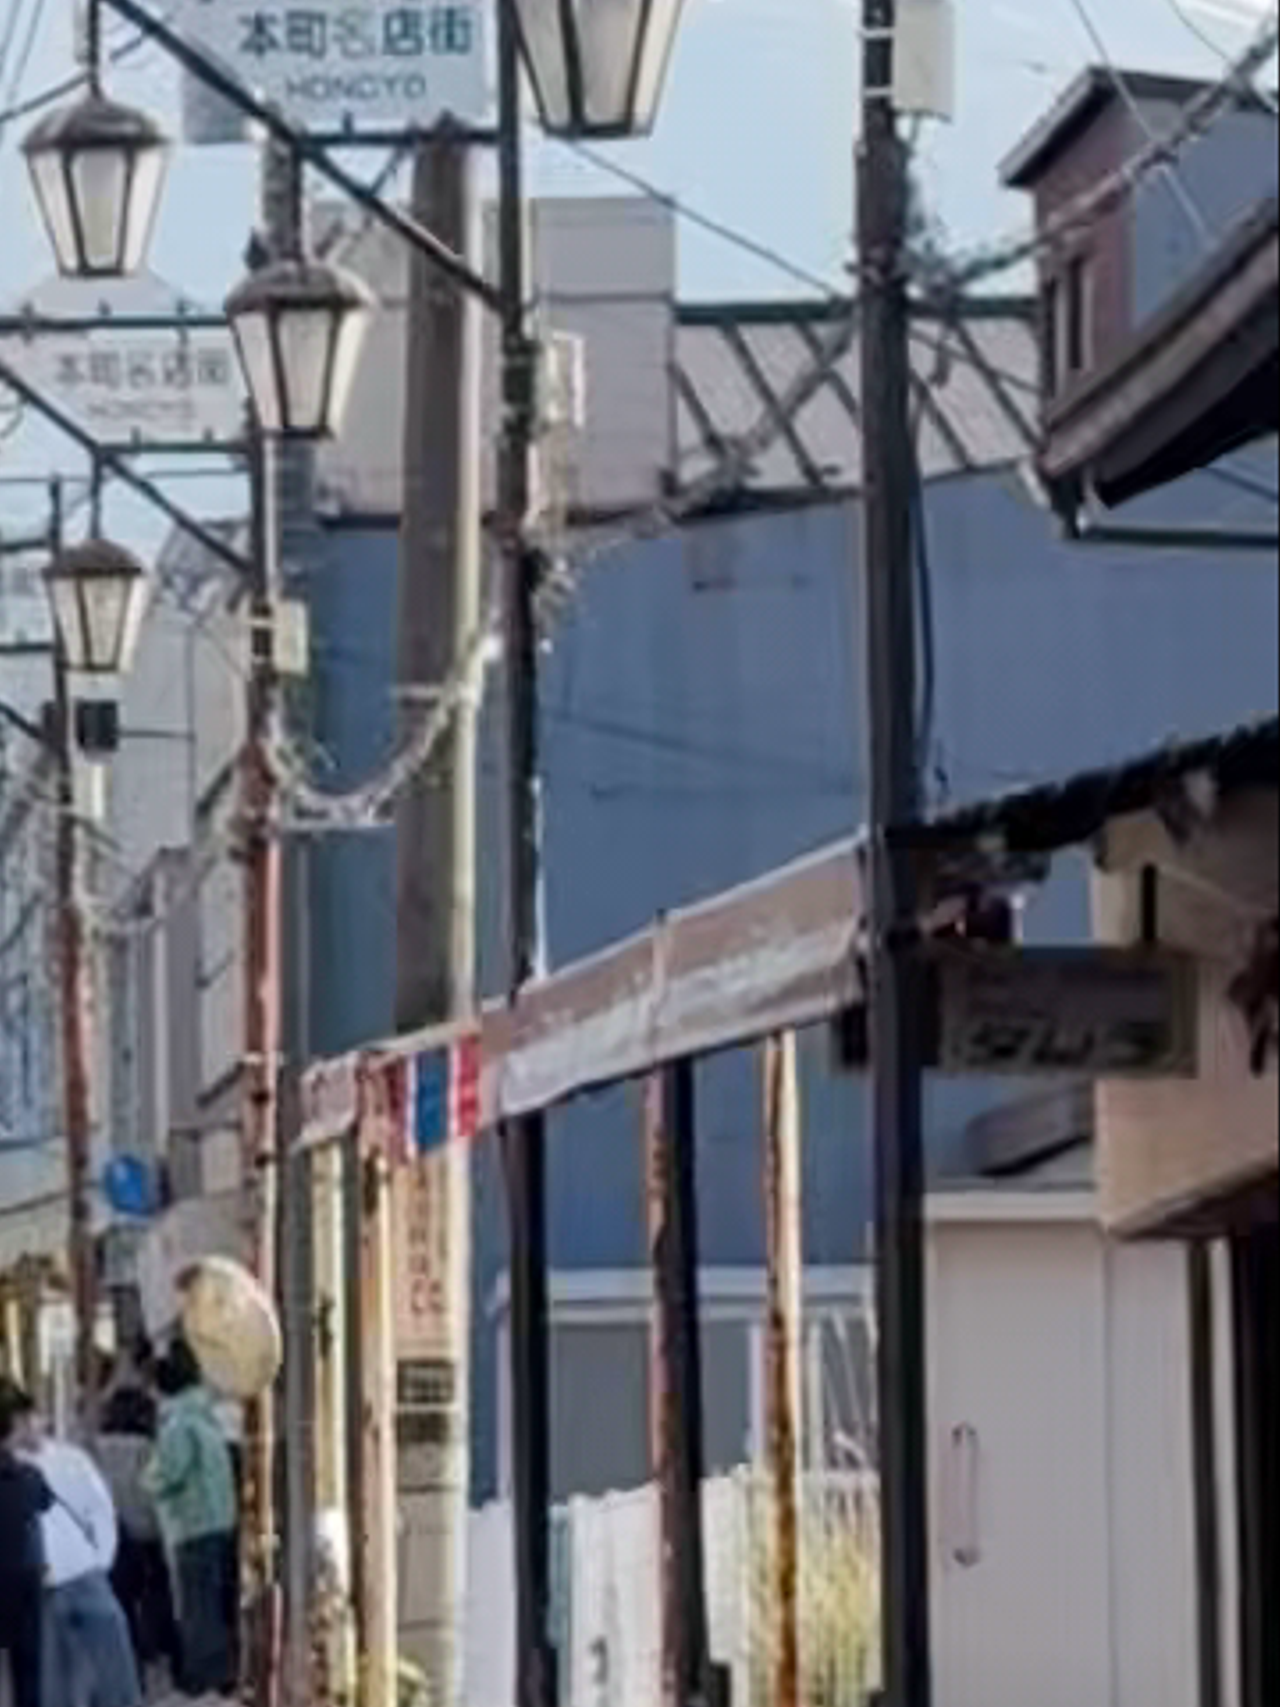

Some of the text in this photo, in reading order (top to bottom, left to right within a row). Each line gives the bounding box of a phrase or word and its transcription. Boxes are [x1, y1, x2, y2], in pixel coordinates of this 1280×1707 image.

[238, 5, 474, 62] 本町名店街
